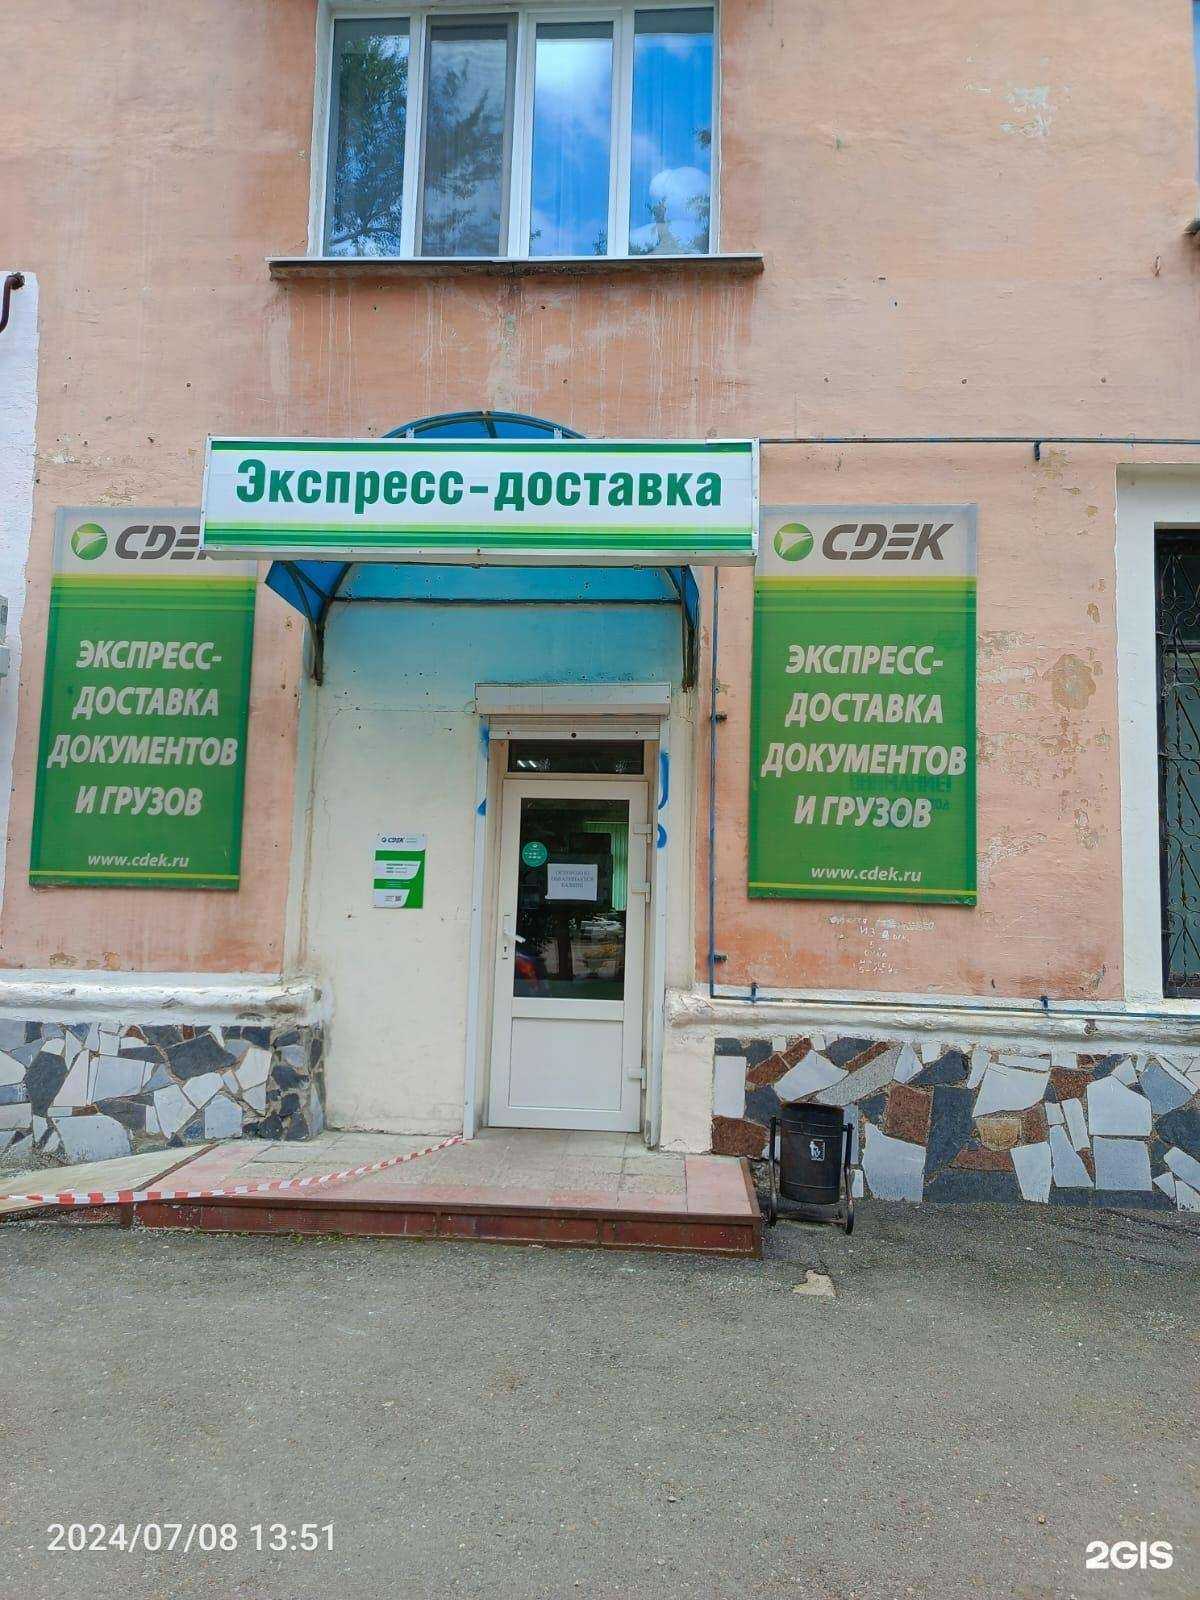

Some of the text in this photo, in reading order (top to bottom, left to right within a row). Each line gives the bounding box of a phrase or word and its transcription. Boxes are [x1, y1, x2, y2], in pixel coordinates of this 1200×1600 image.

[236, 458, 721, 514] Экспресс-доставка
[114, 525, 208, 560] CDE
[822, 523, 954, 561] CDEK
[76, 640, 222, 670] ЭКСПРЕСС-
[785, 644, 944, 675] ЭКСПРЕСС-
[72, 686, 219, 720] ДОСТАВКА
[784, 692, 943, 728] ДОСТАВКА
[46, 734, 238, 769] ДОКУМЕНТОВ
[760, 742, 968, 778] ДОКУМЕНТОВ
[75, 785, 203, 816] И ГРУЗОВ
[793, 795, 932, 828] И ГРУЗОВ
[88, 853, 190, 868] www.cdek.ru
[811, 866, 922, 883] www.cdek.ru
